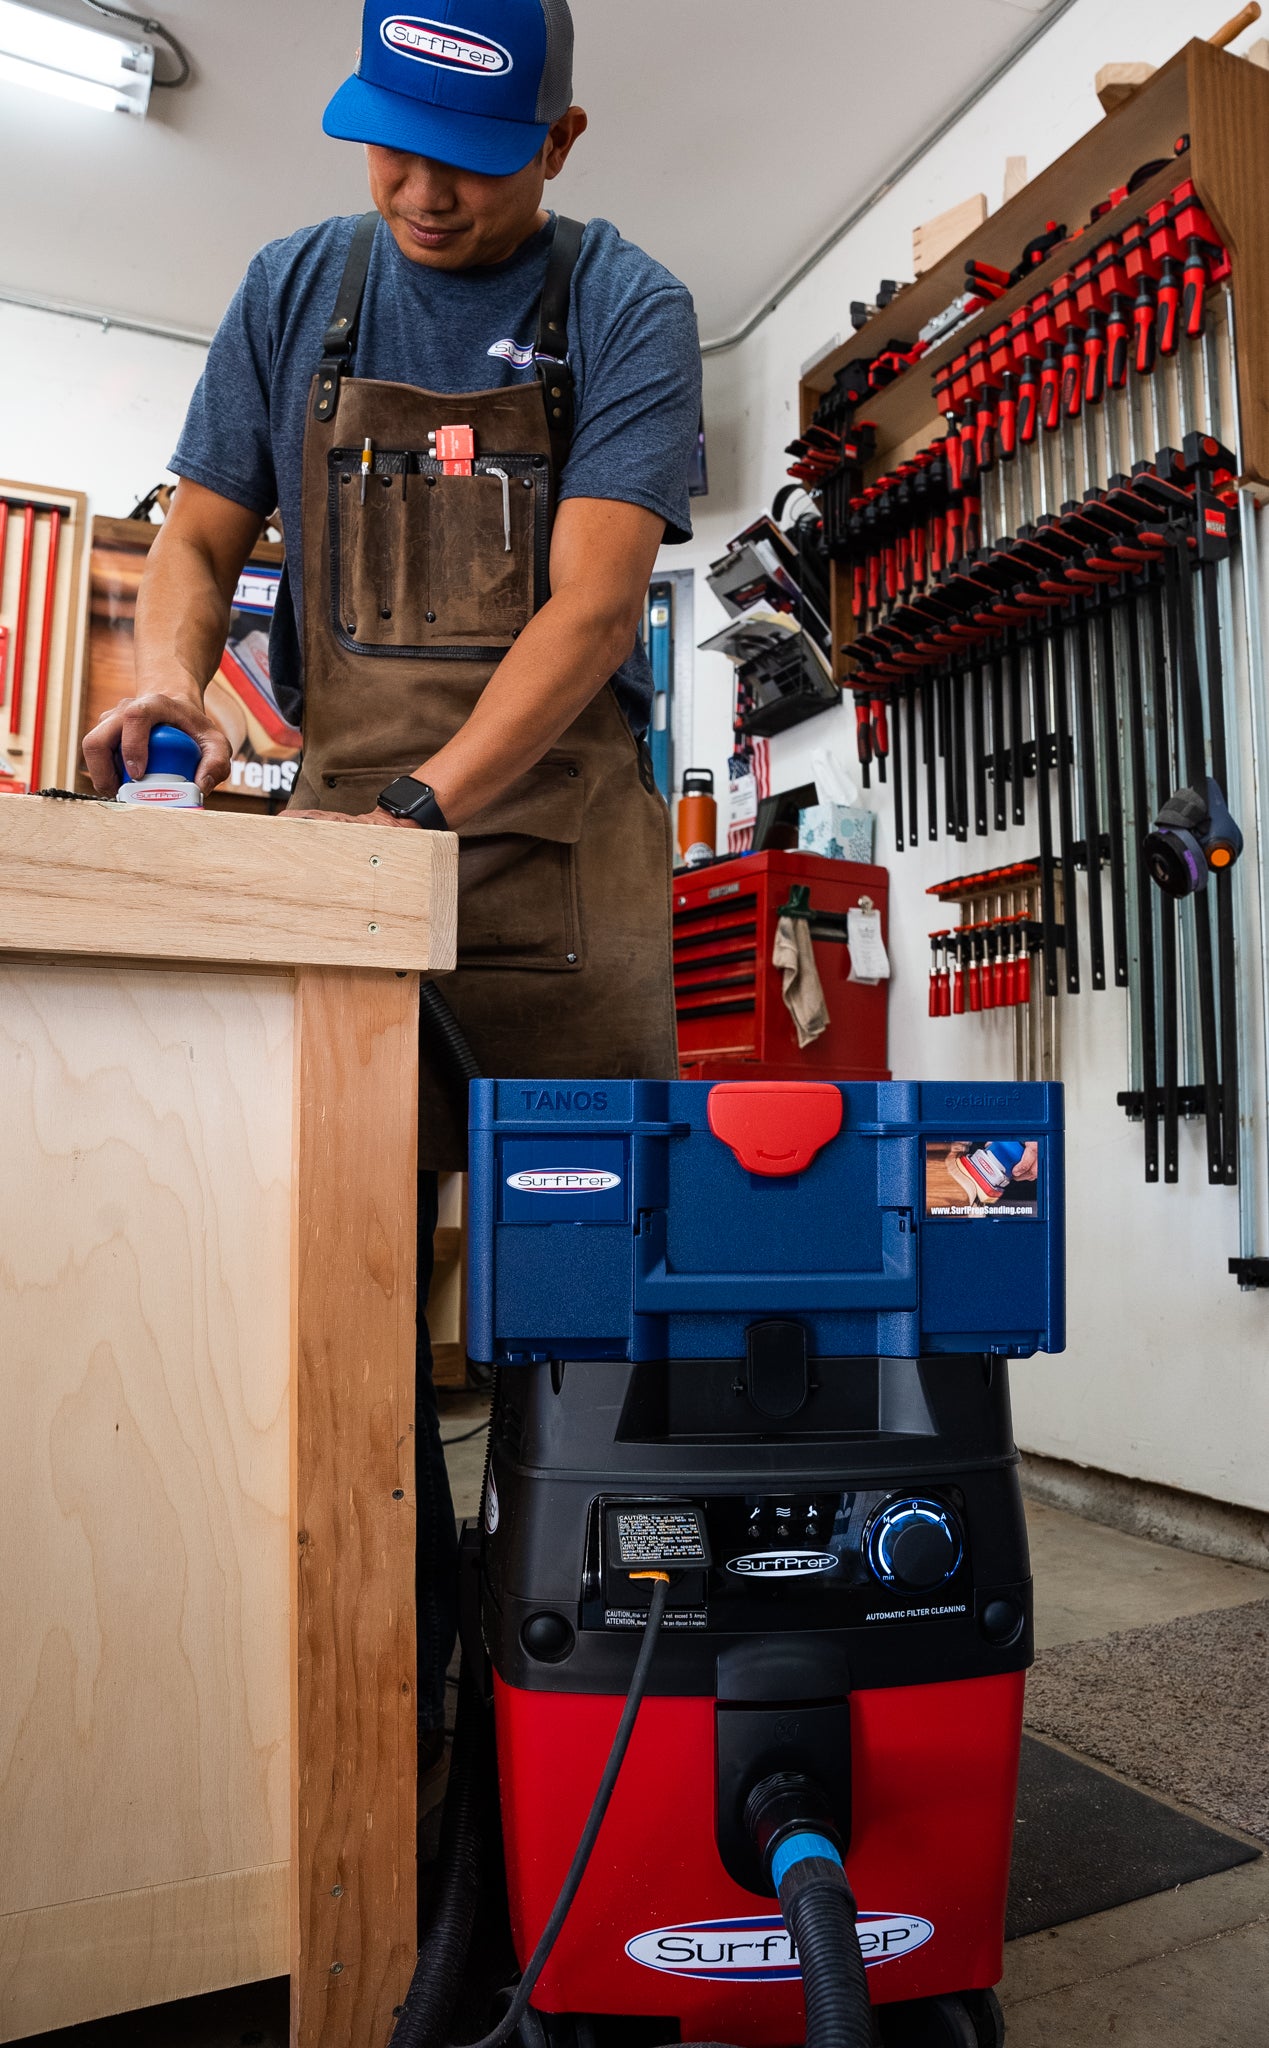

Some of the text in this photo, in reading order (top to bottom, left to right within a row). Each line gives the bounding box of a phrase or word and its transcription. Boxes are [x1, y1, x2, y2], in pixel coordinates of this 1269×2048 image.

[520, 1090, 608, 1111] TANOS
[930, 1205, 1033, 1215] www.SurfPrepSanding.com
[940, 1512, 947, 1520] A
[866, 1605, 966, 1621] AUTOMATIC FILTER CLEANING
